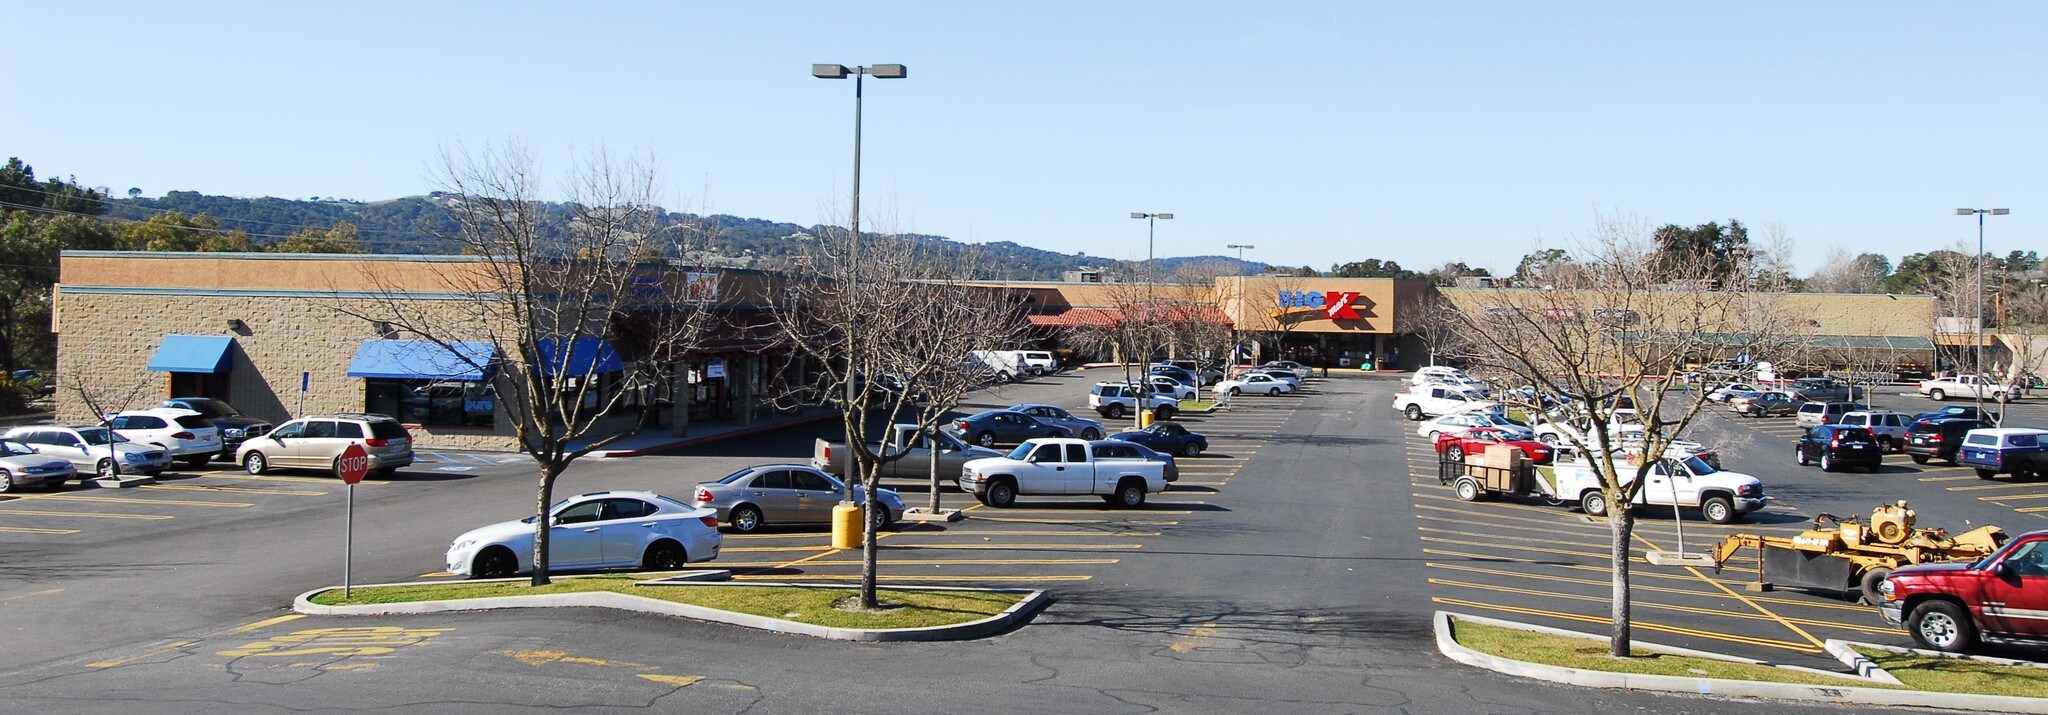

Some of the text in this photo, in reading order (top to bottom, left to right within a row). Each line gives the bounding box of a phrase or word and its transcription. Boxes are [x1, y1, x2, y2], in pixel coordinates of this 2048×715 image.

[1279, 290, 1361, 319] BIG K
[1328, 293, 1349, 317] mart
[341, 456, 367, 473] STOP
